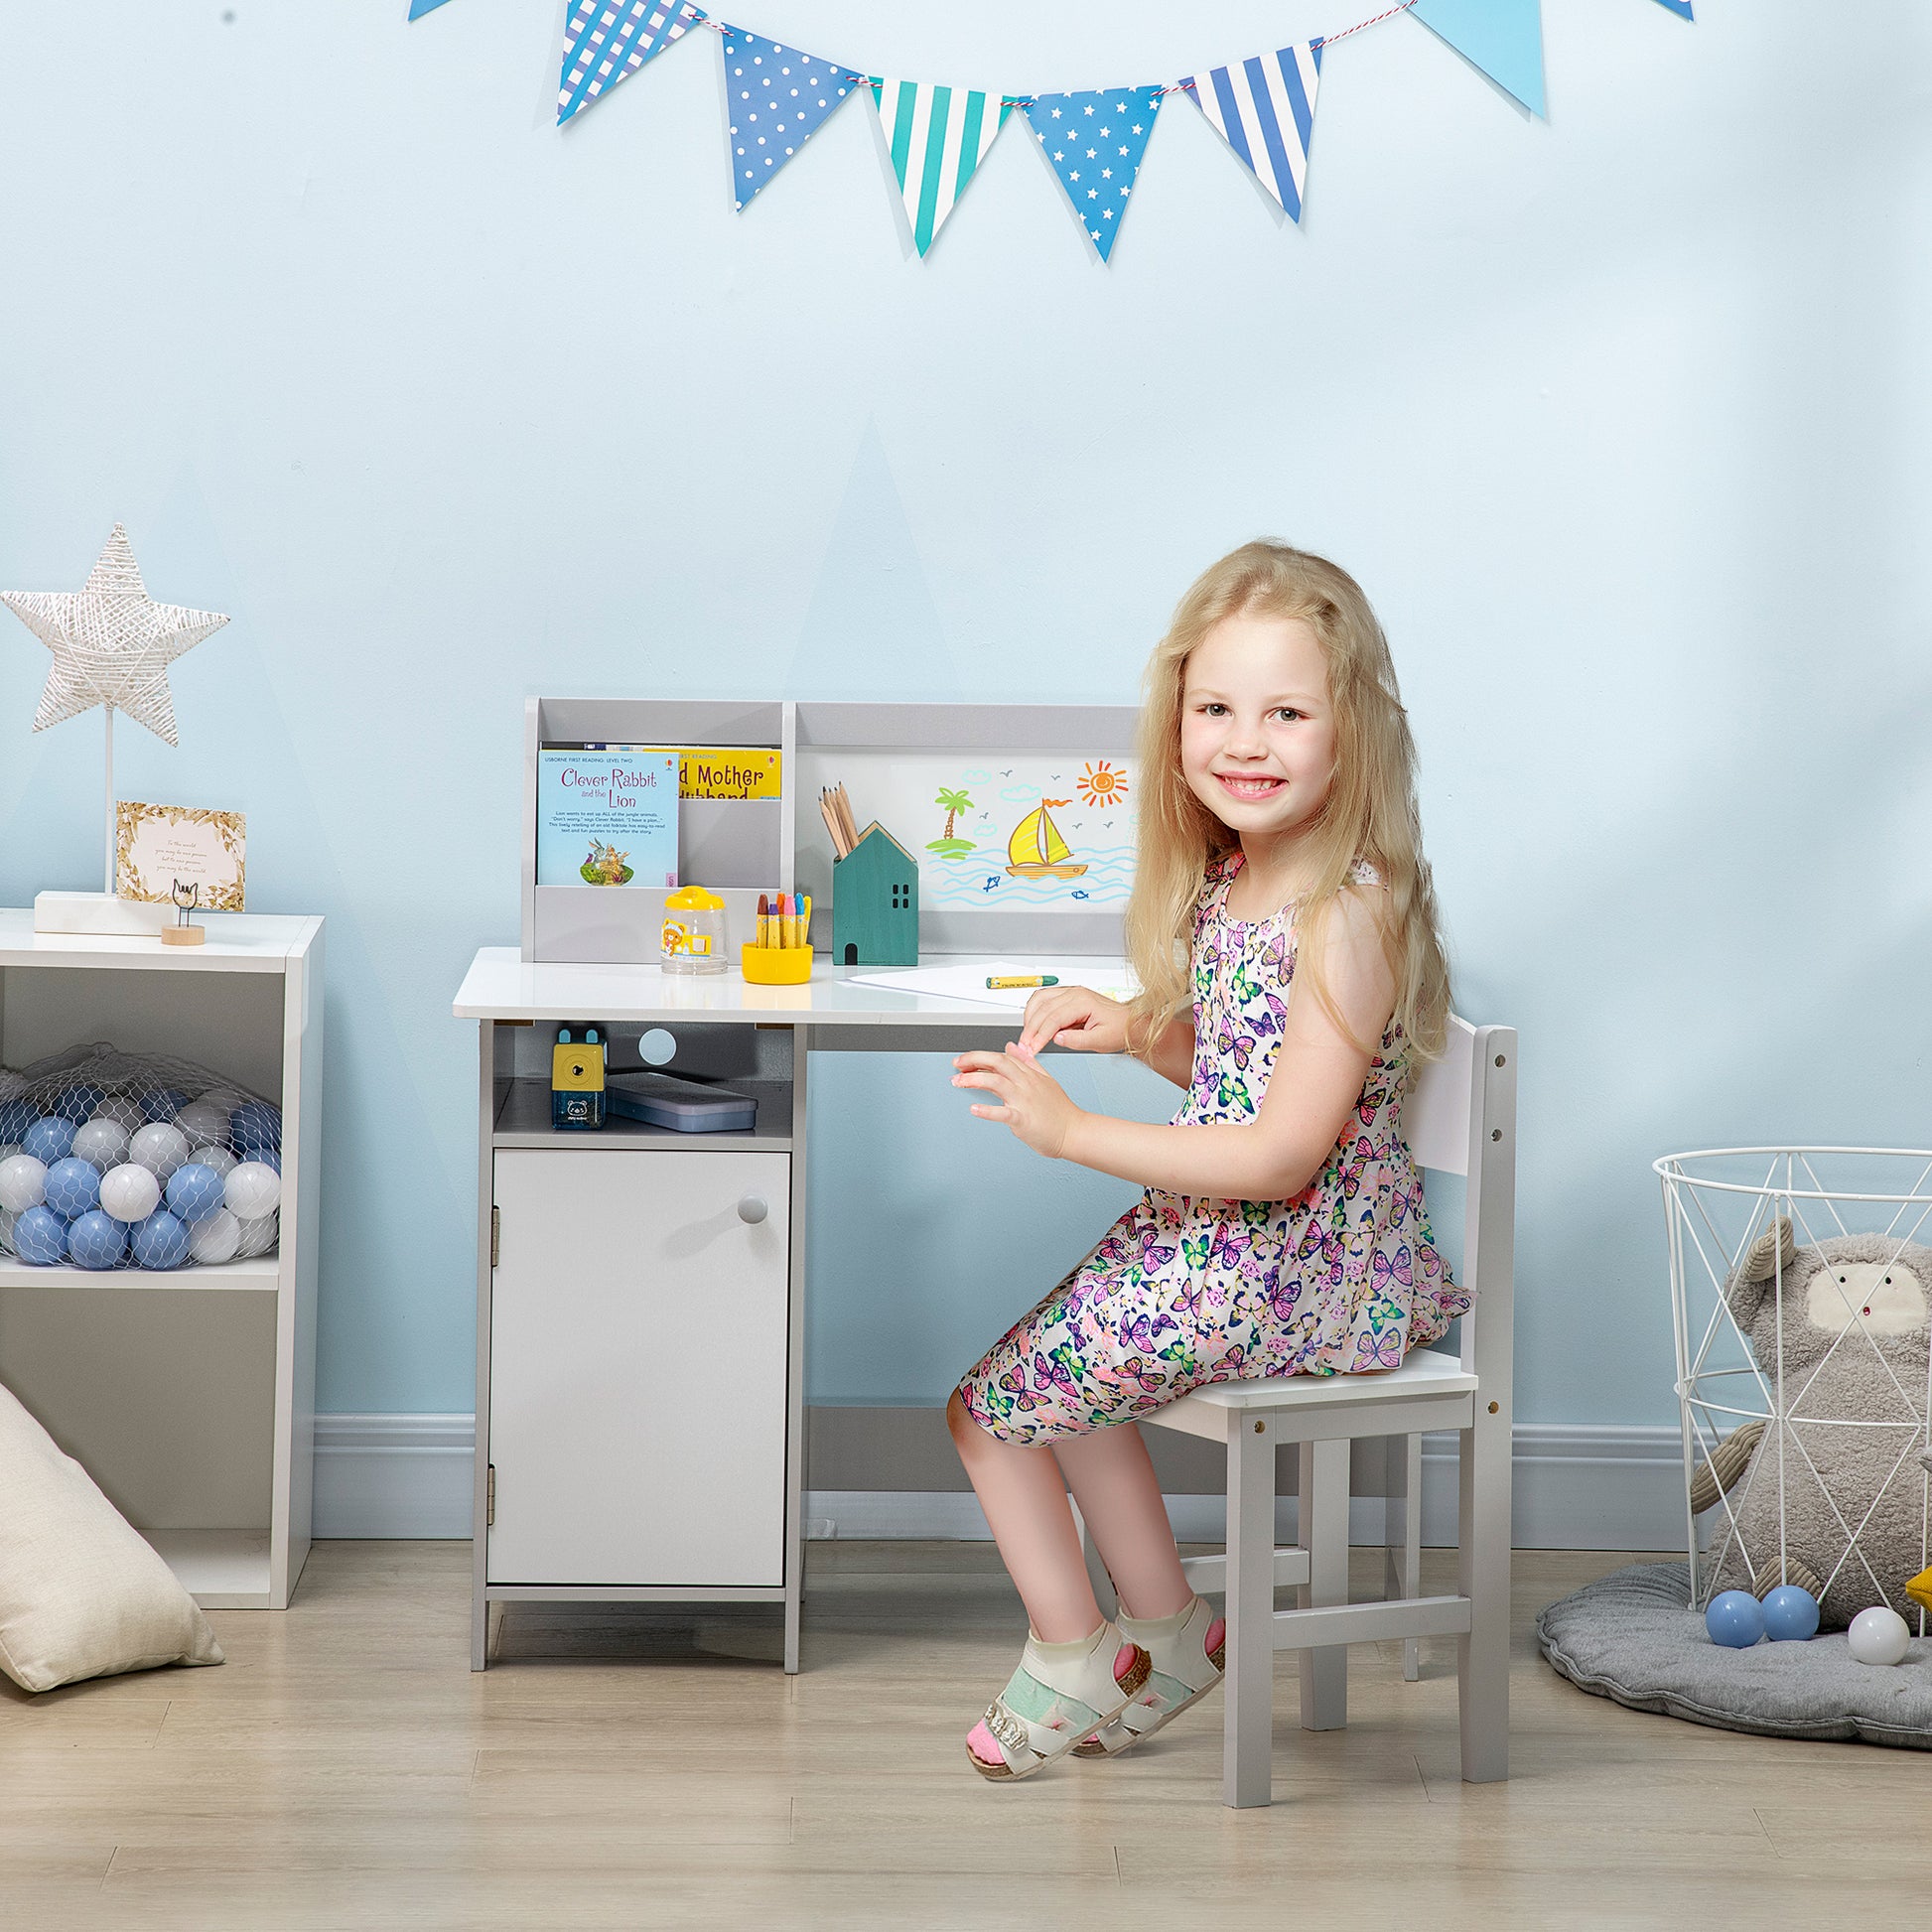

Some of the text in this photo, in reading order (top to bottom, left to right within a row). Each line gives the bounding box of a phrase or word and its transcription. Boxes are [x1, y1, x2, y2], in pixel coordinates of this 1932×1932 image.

[561, 768, 657, 789] Clever Rabbit
[698, 764, 763, 789] Mother
[609, 789, 636, 808] Lion
